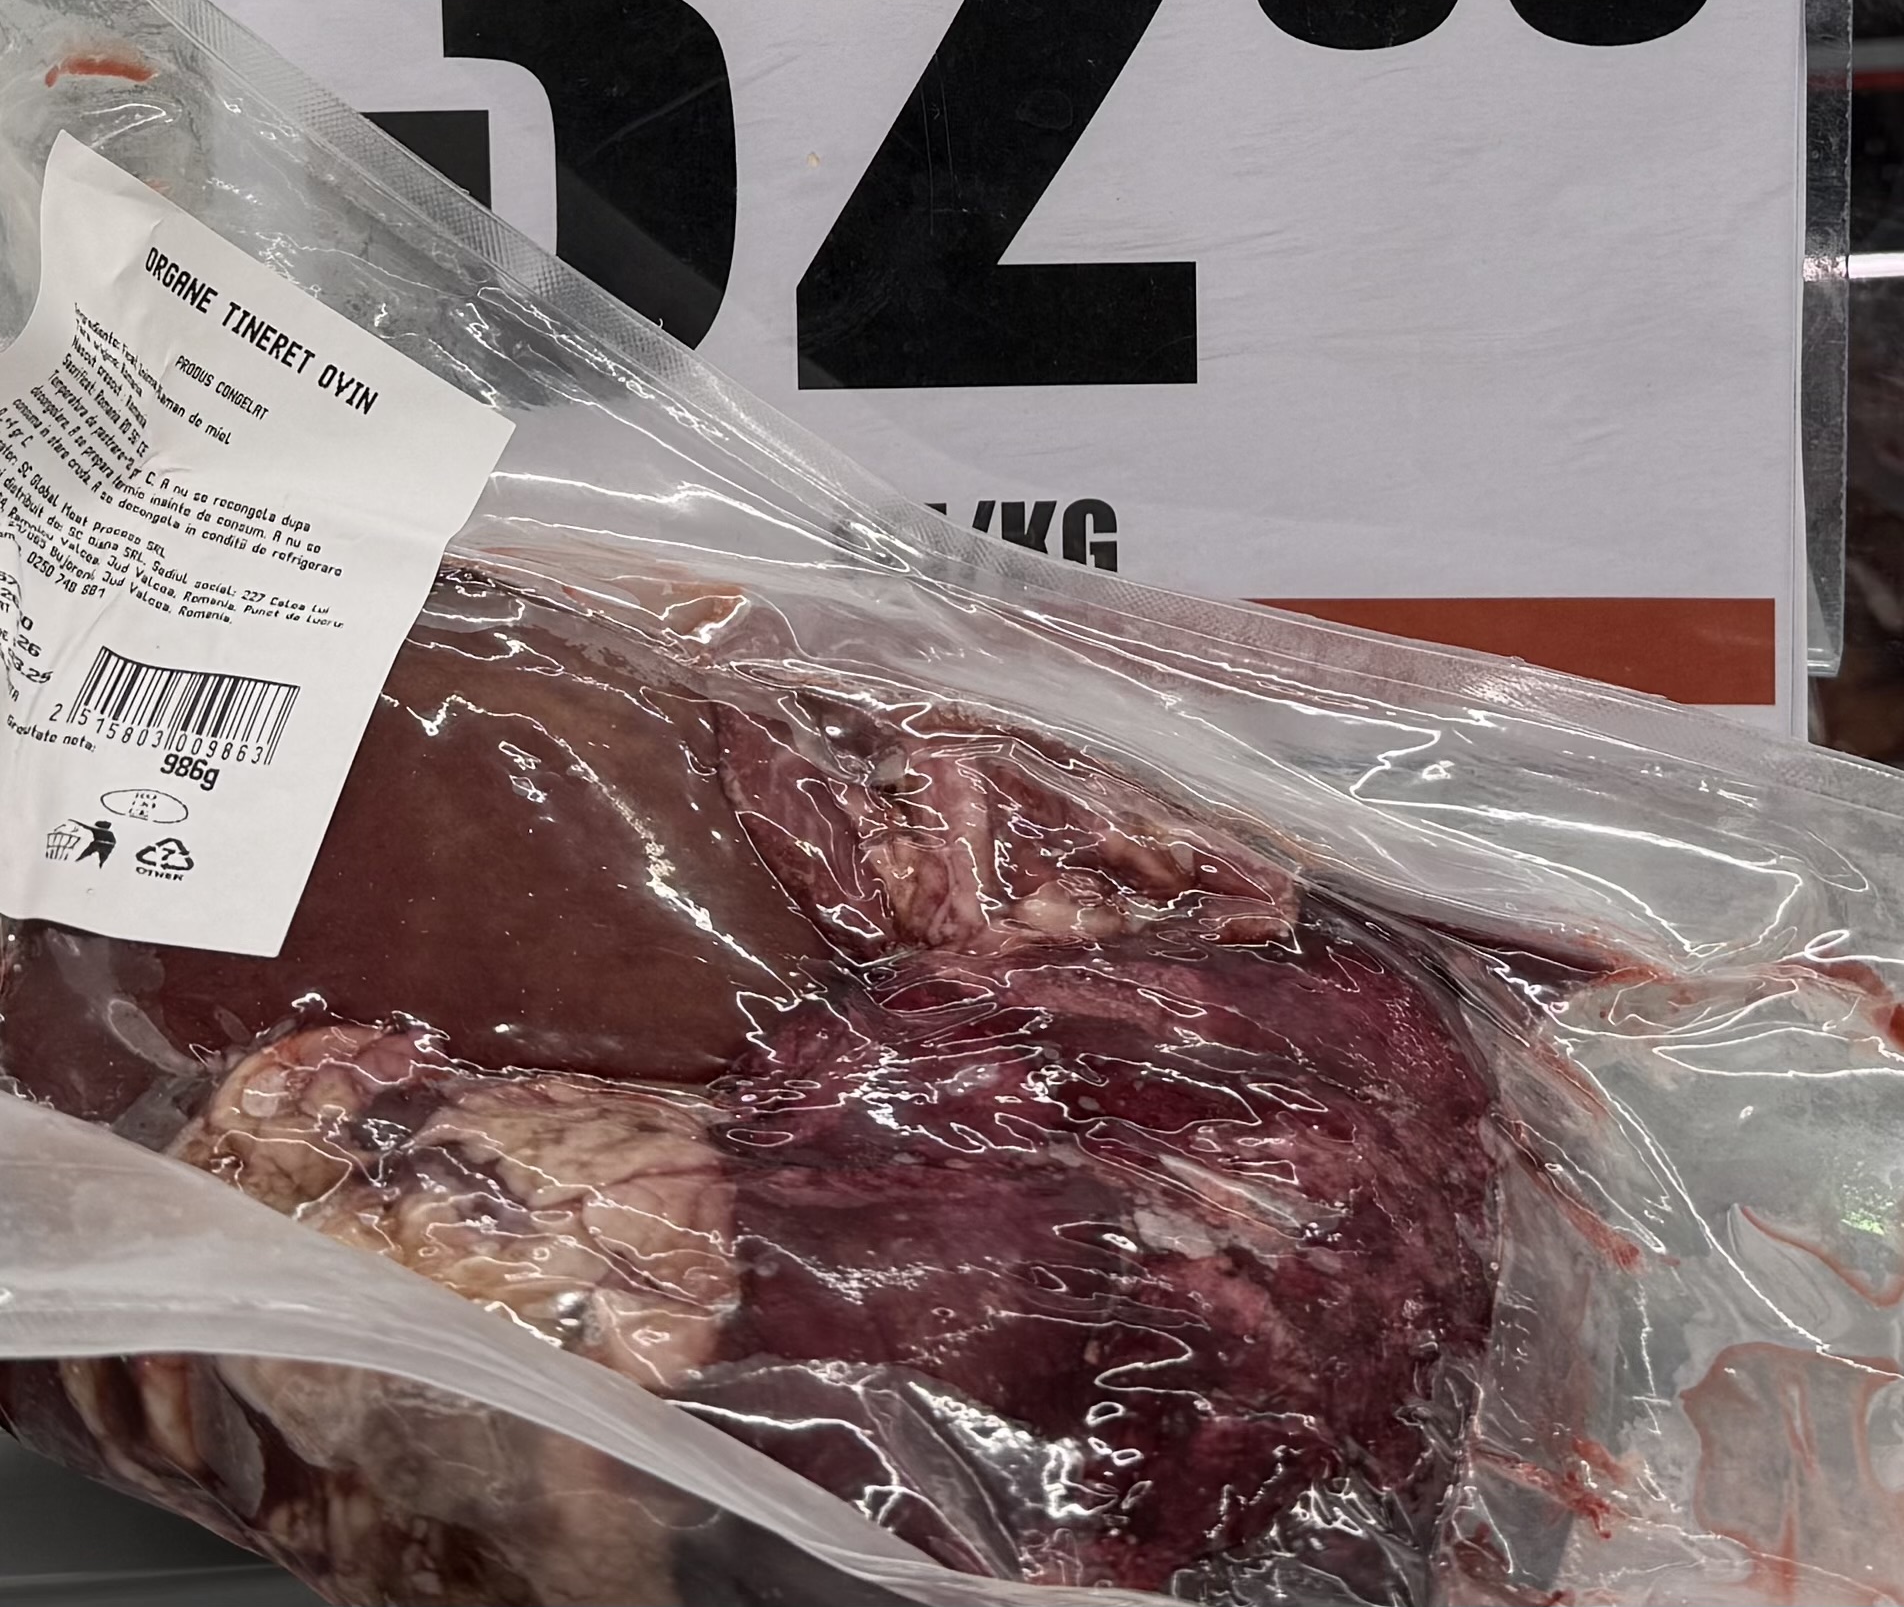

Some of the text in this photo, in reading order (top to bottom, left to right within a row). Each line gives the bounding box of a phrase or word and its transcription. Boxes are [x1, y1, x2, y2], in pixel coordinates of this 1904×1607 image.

[145, 246, 379, 415] ORGANE TINERET OVIN
[176, 355, 269, 421] PRODUS CONGELAT
[188, 413, 202, 427] de
[205, 423, 232, 444] miel
[18, 462, 33, 477] SC
[30, 475, 59, 507] Global
[62, 503, 88, 527] Meat
[146, 541, 166, 559] SRL
[47, 435, 70, 460] stare
[91, 480, 103, 493] A
[100, 492, 112, 504] se
[118, 499, 180, 529] decongela
[185, 523, 196, 536] in
[252, 543, 267, 555] de
[272, 551, 343, 577] refrigerare
[81, 446, 114, 478] prepara
[150, 493, 191, 517] inainte
[197, 509, 211, 522] de
[216, 517, 267, 539] consum.
[273, 530, 283, 542] A
[286, 537, 301, 548] nu
[306, 543, 321, 554] se
[161, 478, 170, 489] A
[173, 486, 188, 497] nu
[193, 493, 208, 503] se
[213, 497, 276, 523] recongela
[281, 512, 311, 533] dupa
[4, 478, 45, 519] distribuit
[69, 527, 84, 539] SC
[123, 547, 146, 566] SRL.
[152, 561, 188, 584] Sediul
[194, 581, 236, 597] social:
[241, 590, 266, 602] 227
[270, 597, 306, 611] Calea
[26, 551, 55, 578] 0250
[102, 571, 125, 586] Jud
[107, 556, 129, 573] Jud
[244, 605, 280, 618] Punct
[286, 613, 300, 622] de
[160, 753, 220, 792] 986g
